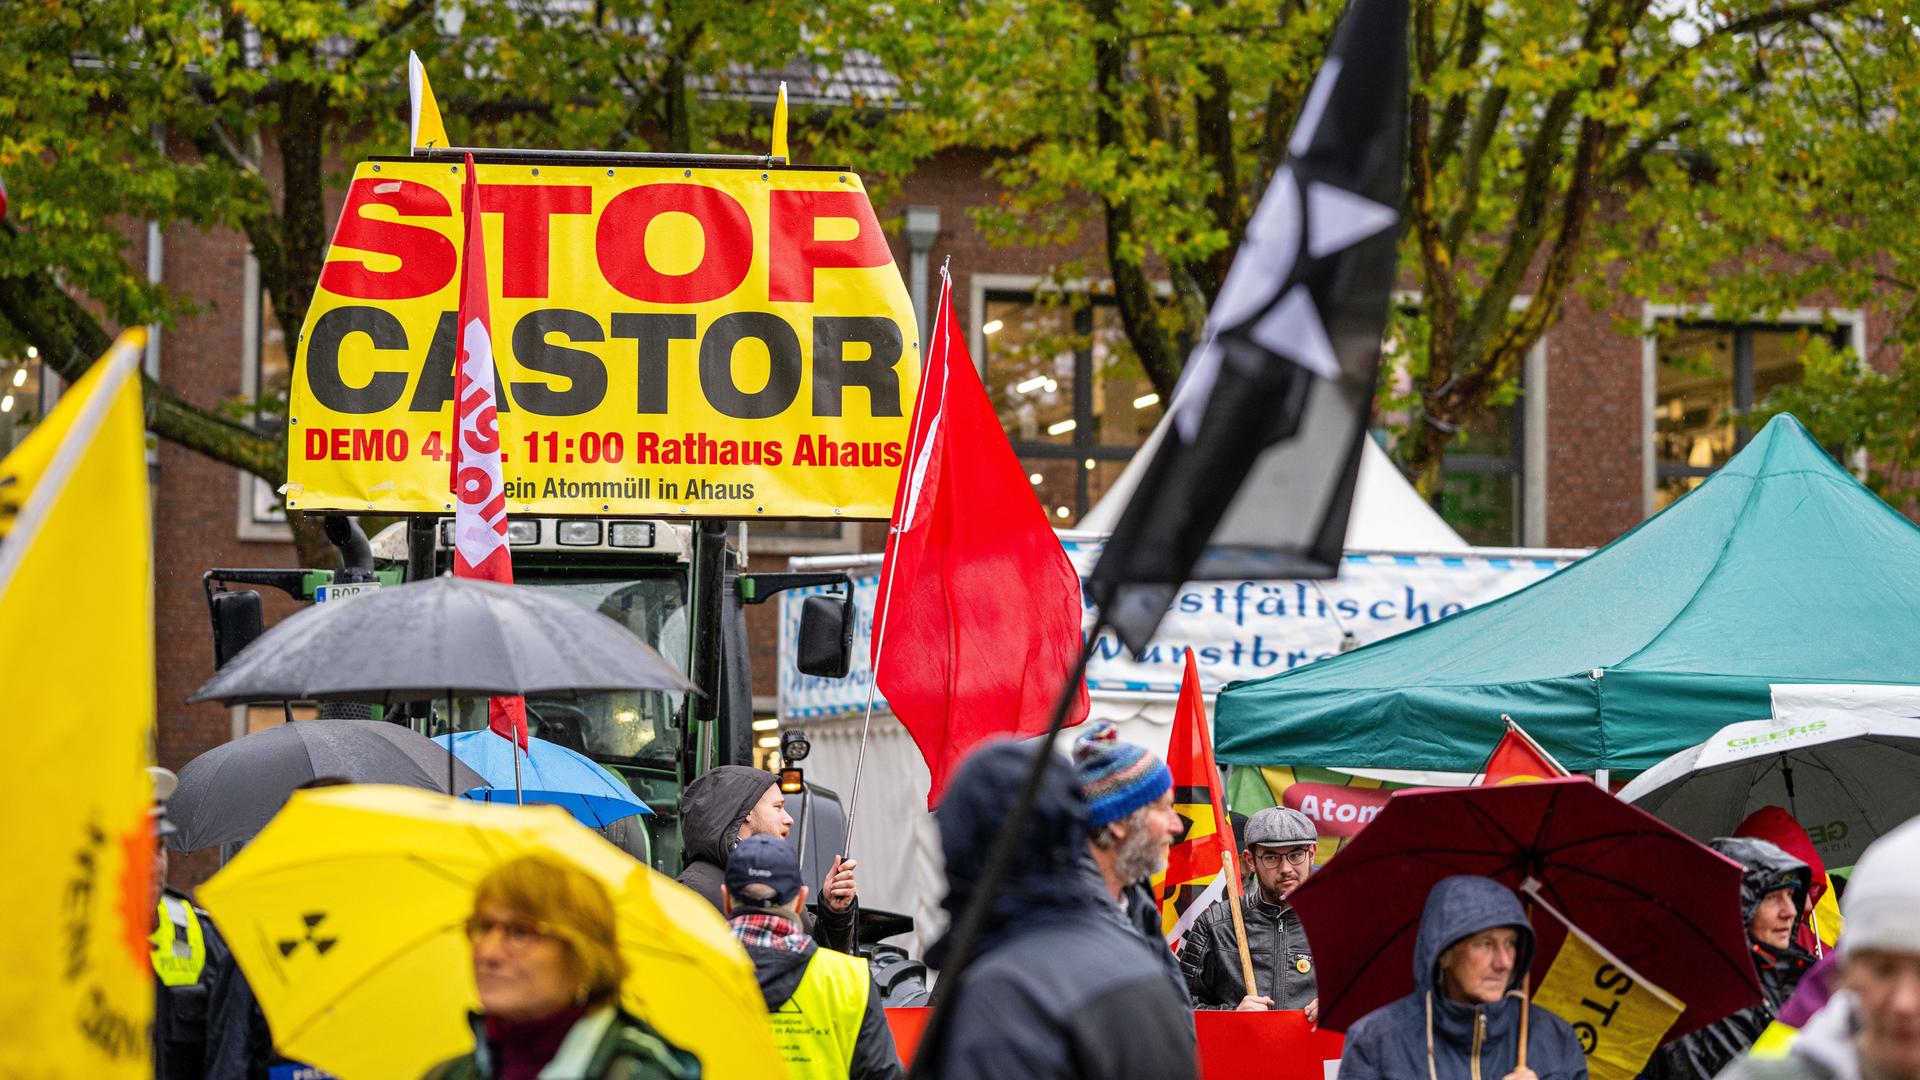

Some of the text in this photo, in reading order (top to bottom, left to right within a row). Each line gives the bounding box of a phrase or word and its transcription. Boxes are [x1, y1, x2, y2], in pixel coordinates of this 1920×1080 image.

[319, 177, 893, 304] STOP
[305, 306, 904, 419] CASTOR
[305, 428, 409, 462] DEMO
[523, 431, 624, 464] 11:00
[637, 432, 783, 467] Rathaus
[792, 434, 903, 468] Ahaus
[503, 477, 755, 501] ein Atommüll in Ahaus
[1082, 576, 1465, 625] stfälische
[1727, 721, 1826, 747] GEERS
